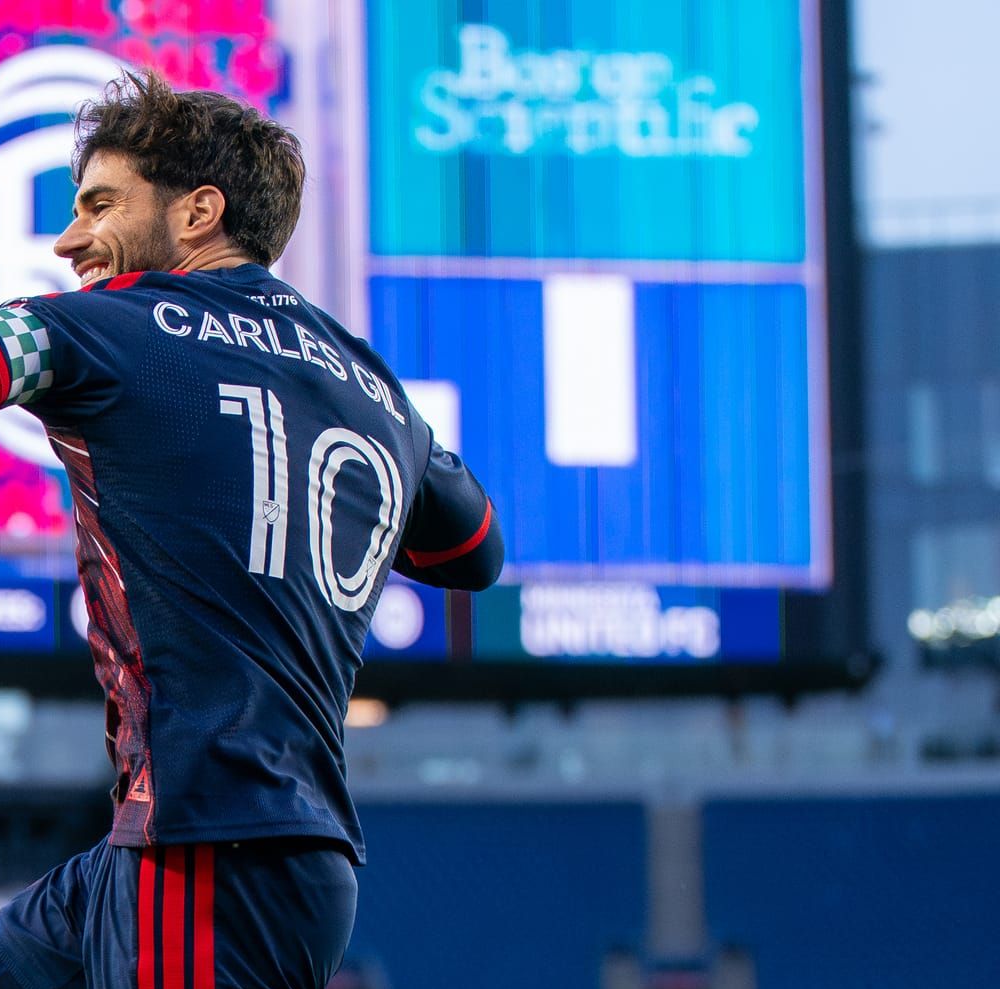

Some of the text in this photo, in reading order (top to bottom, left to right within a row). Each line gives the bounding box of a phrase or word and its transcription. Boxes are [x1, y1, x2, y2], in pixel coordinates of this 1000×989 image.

[272, 294, 298, 307] 1776
[152, 301, 406, 425] CARLES GIL
[218, 383, 403, 612] 10
